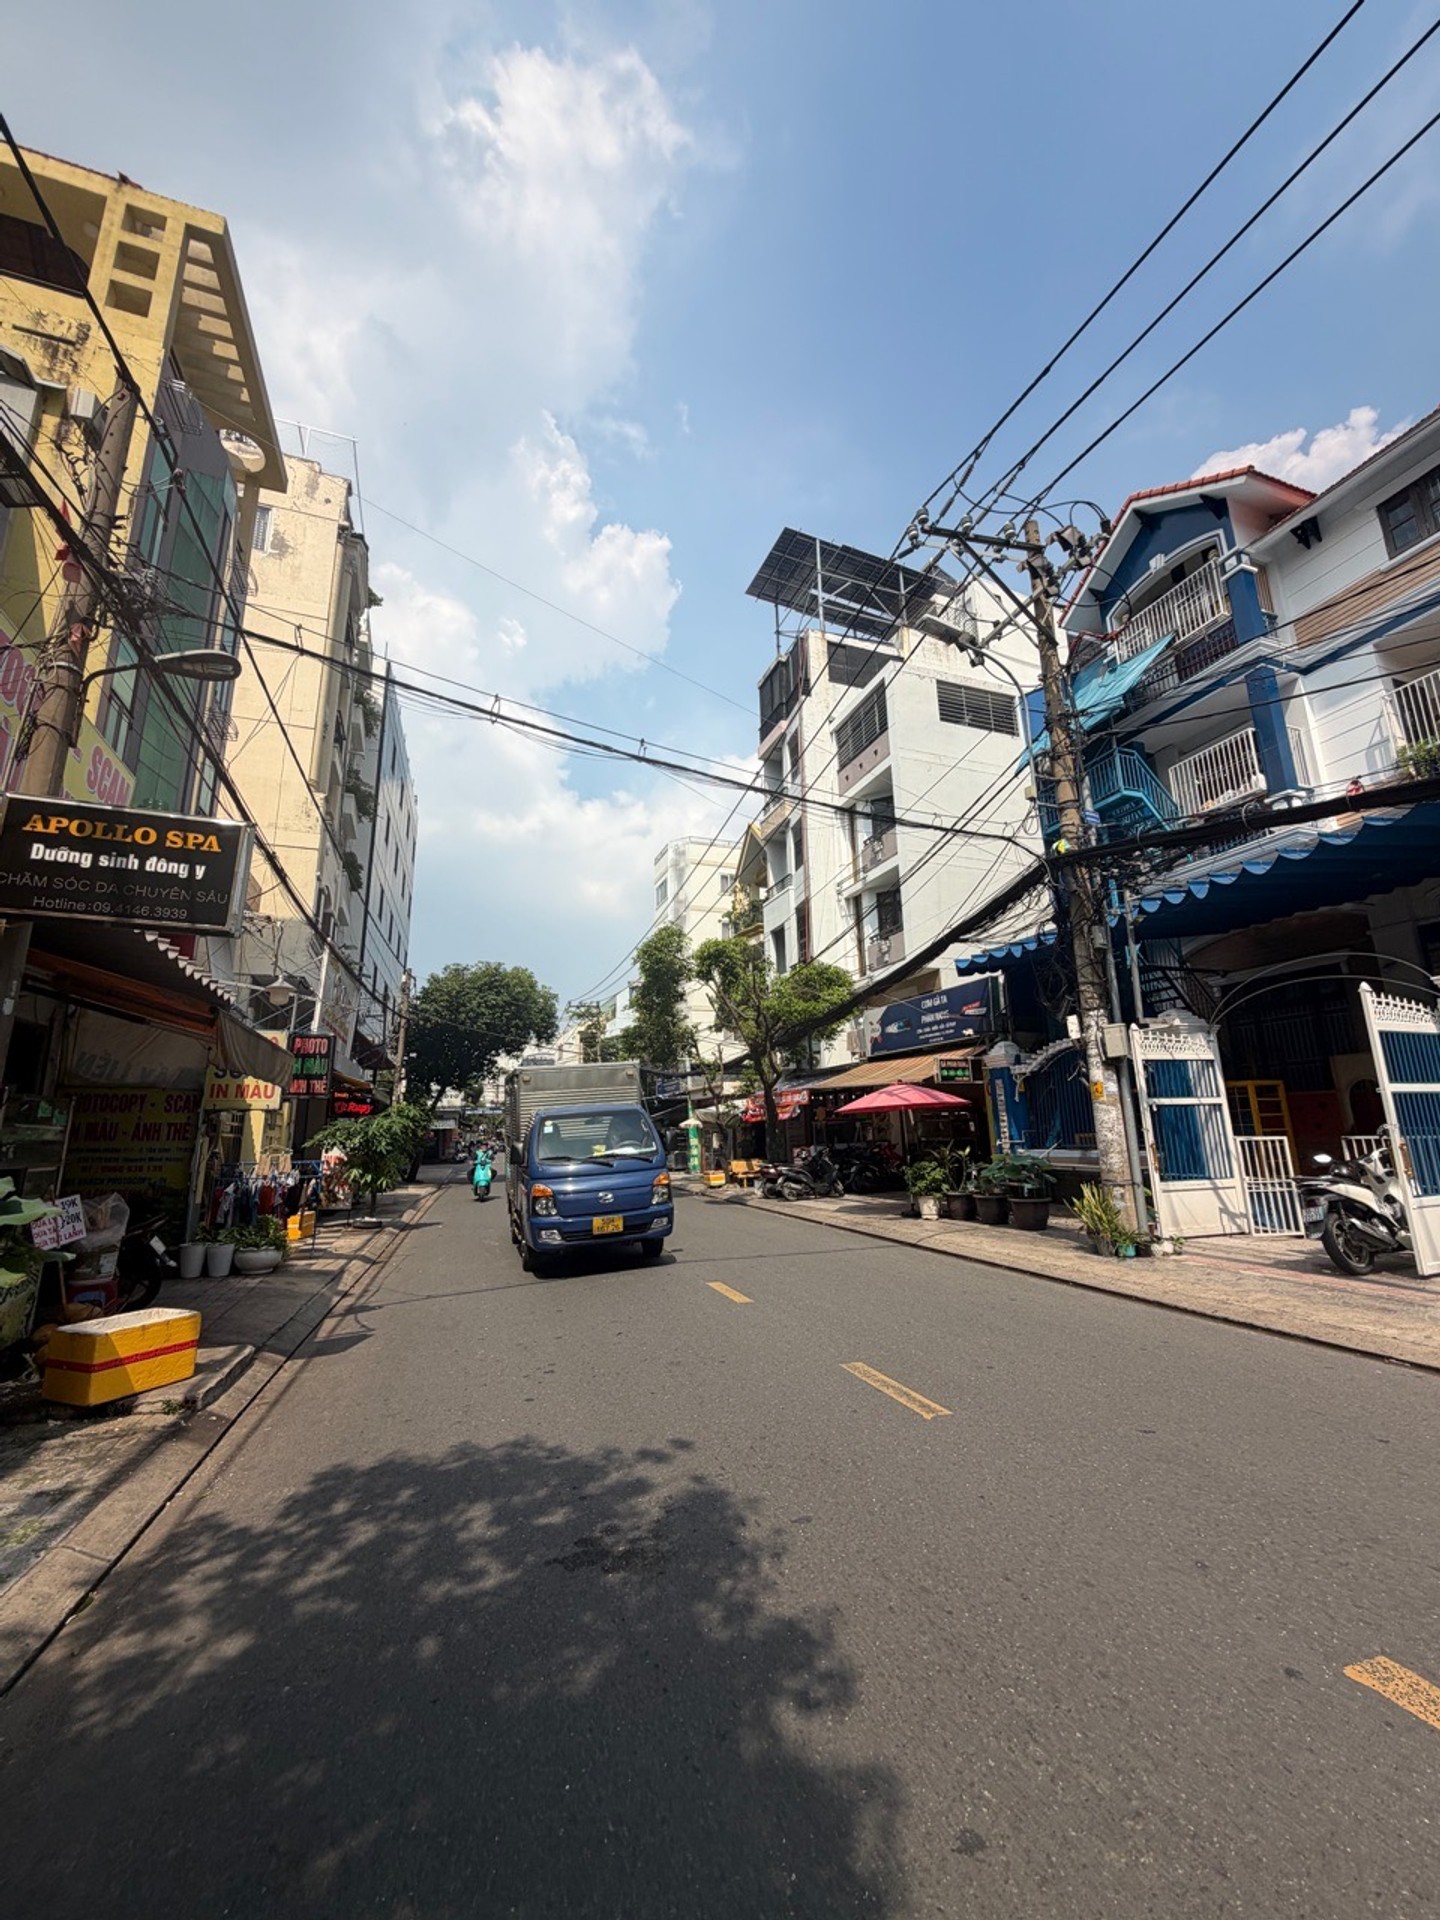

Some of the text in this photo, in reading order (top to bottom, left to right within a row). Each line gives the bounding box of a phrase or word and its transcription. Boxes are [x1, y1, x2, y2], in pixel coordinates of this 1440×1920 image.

[22, 815, 221, 852] APOLLO SPA
[30, 843, 207, 880] Dưỡng sinh đông y
[0, 872, 48, 887] CHĂM
[52, 876, 91, 892] SÓC
[123, 884, 193, 901] CHUYÊN
[196, 889, 228, 905] SÂU
[294, 1037, 329, 1054] PHOTO
[210, 1080, 275, 1099] IN MÀU
[131, 1115, 162, 1141] ẢNH
[166, 1115, 192, 1141] THẺ
